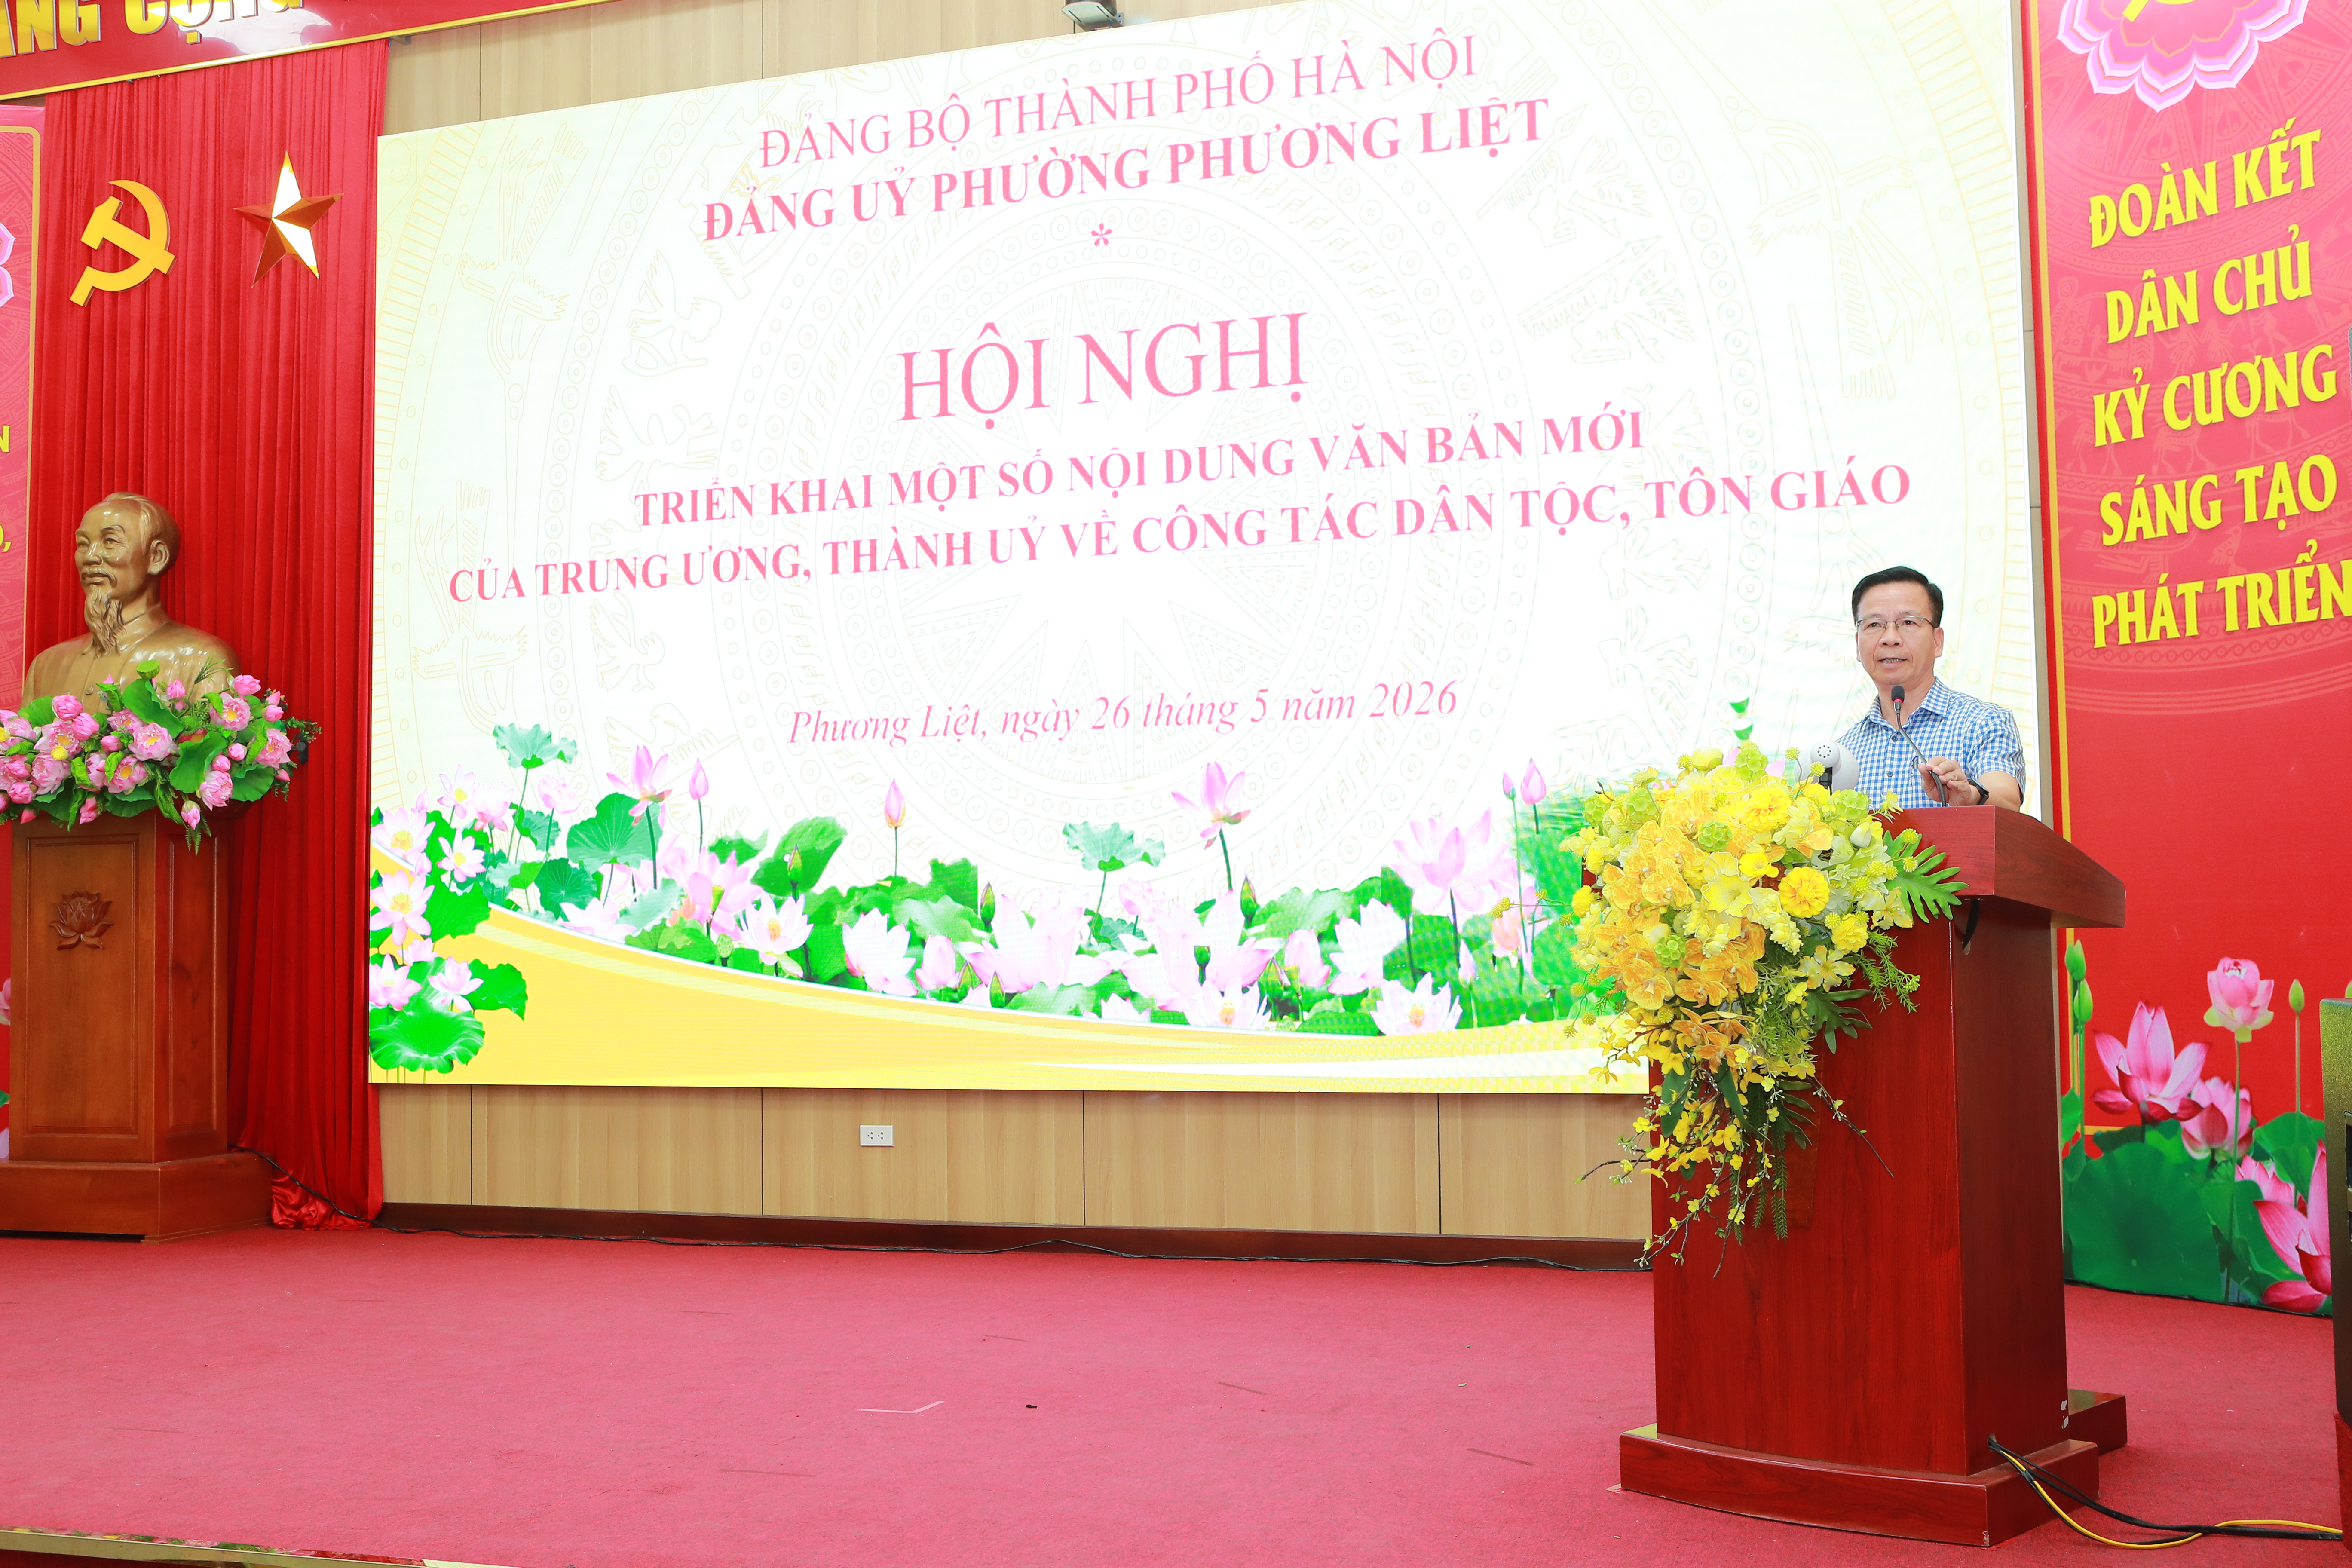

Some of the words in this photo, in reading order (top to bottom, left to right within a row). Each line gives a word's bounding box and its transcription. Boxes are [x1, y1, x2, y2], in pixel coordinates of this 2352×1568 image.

[759, 113, 892, 168] ĐẢNG
[907, 93, 970, 151] BỘ
[984, 78, 1156, 137] THÀNH
[1174, 51, 1274, 113] PHỐ
[1292, 40, 1365, 98] HÀ
[1380, 27, 1475, 89] NỘI
[703, 186, 835, 241] ĐẢNG
[851, 167, 916, 221] UỶ
[932, 146, 1149, 211] PHƯỜNG
[1167, 117, 1400, 183] PHƯƠNG
[1419, 97, 1548, 157] LIỆT
[2089, 161, 2218, 247] ĐOÀN
[2232, 117, 2321, 208] KẾT
[2105, 269, 2199, 343] DÂN
[2214, 224, 2312, 314] CHỦ
[897, 322, 1050, 429] HỘI
[1075, 312, 1308, 404] NGHỊ
[2094, 368, 2150, 446] KỶ
[2163, 345, 2337, 430] CƯƠNG
[635, 477, 755, 526] TRIỂN
[769, 475, 873, 515] KHAI
[888, 462, 985, 511] MỘT
[999, 449, 1053, 496] SỐ
[1068, 447, 1146, 498] NỘI
[1164, 439, 1294, 484] DUNG
[1309, 423, 1407, 471] VĂN
[1426, 413, 1522, 463] BẢN
[1543, 401, 1644, 454] MỚI
[2101, 473, 2222, 545] SÁNG
[2236, 455, 2337, 530] TẠO
[450, 558, 525, 602] CỦA
[535, 554, 668, 595] TRUNG
[683, 544, 811, 585] ƯƠNG,
[823, 526, 973, 575] THÀNH
[989, 516, 1046, 563] UỶ
[1060, 510, 1117, 557] VỀ
[1133, 504, 1267, 553] CÔNG
[1281, 493, 1377, 542] TÁC
[1395, 484, 1494, 535] DÂN
[1510, 481, 1629, 536] TỘC,
[1644, 467, 1753, 518] TÔN
[1771, 456, 1910, 510] GIÁO
[2092, 573, 2204, 648] PHÁT
[2217, 539, 2352, 631] TRIỂN
[788, 710, 910, 747] Phương
[920, 704, 986, 742] Liệt,
[1002, 699, 1079, 742] ngày
[1091, 696, 1130, 729] 26
[1143, 692, 1238, 733] tháng
[1251, 689, 1268, 722] 5
[1283, 688, 1354, 720] năm
[1370, 680, 1457, 717] 2026
